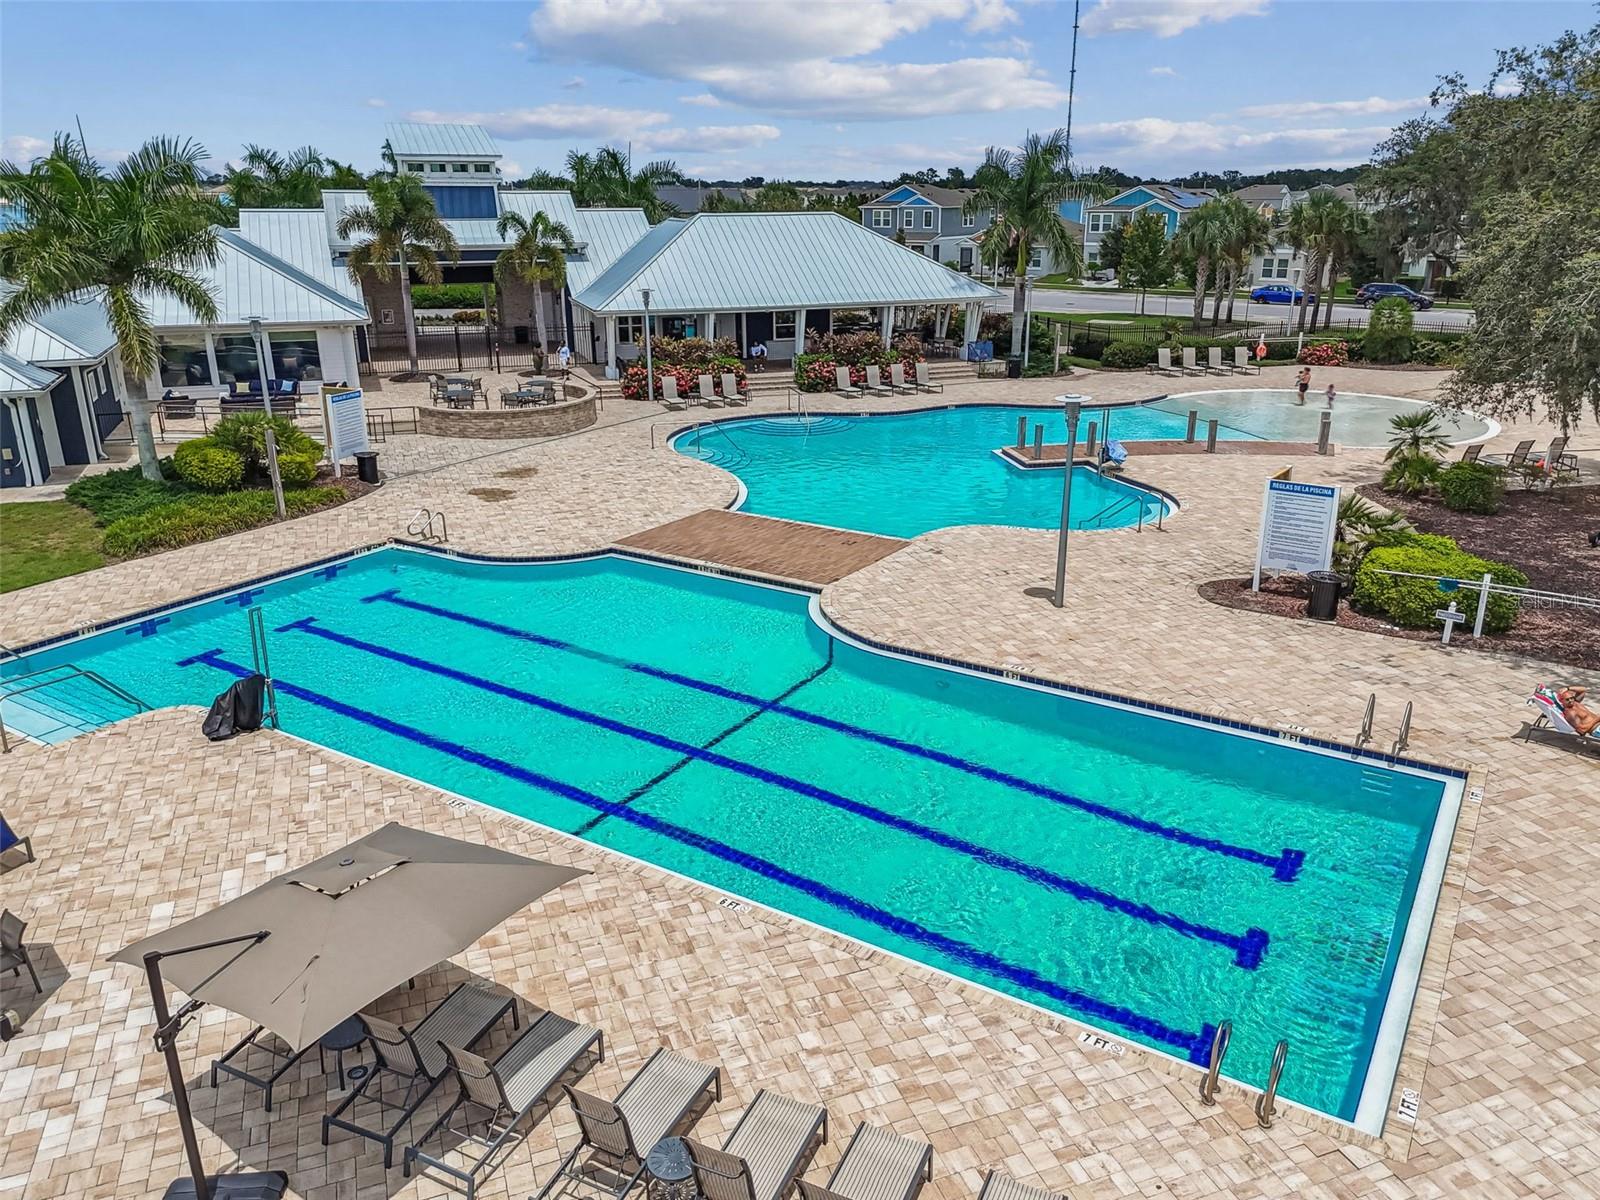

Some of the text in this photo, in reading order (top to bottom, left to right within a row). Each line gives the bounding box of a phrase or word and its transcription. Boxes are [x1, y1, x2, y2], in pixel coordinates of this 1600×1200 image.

[1272, 482, 1293, 491] REGLAS
[1310, 487, 1333, 496] PISCINA
[727, 900, 741, 910] FT
[1083, 1033, 1110, 1049] 7 FT
[1401, 1098, 1417, 1112] FT
